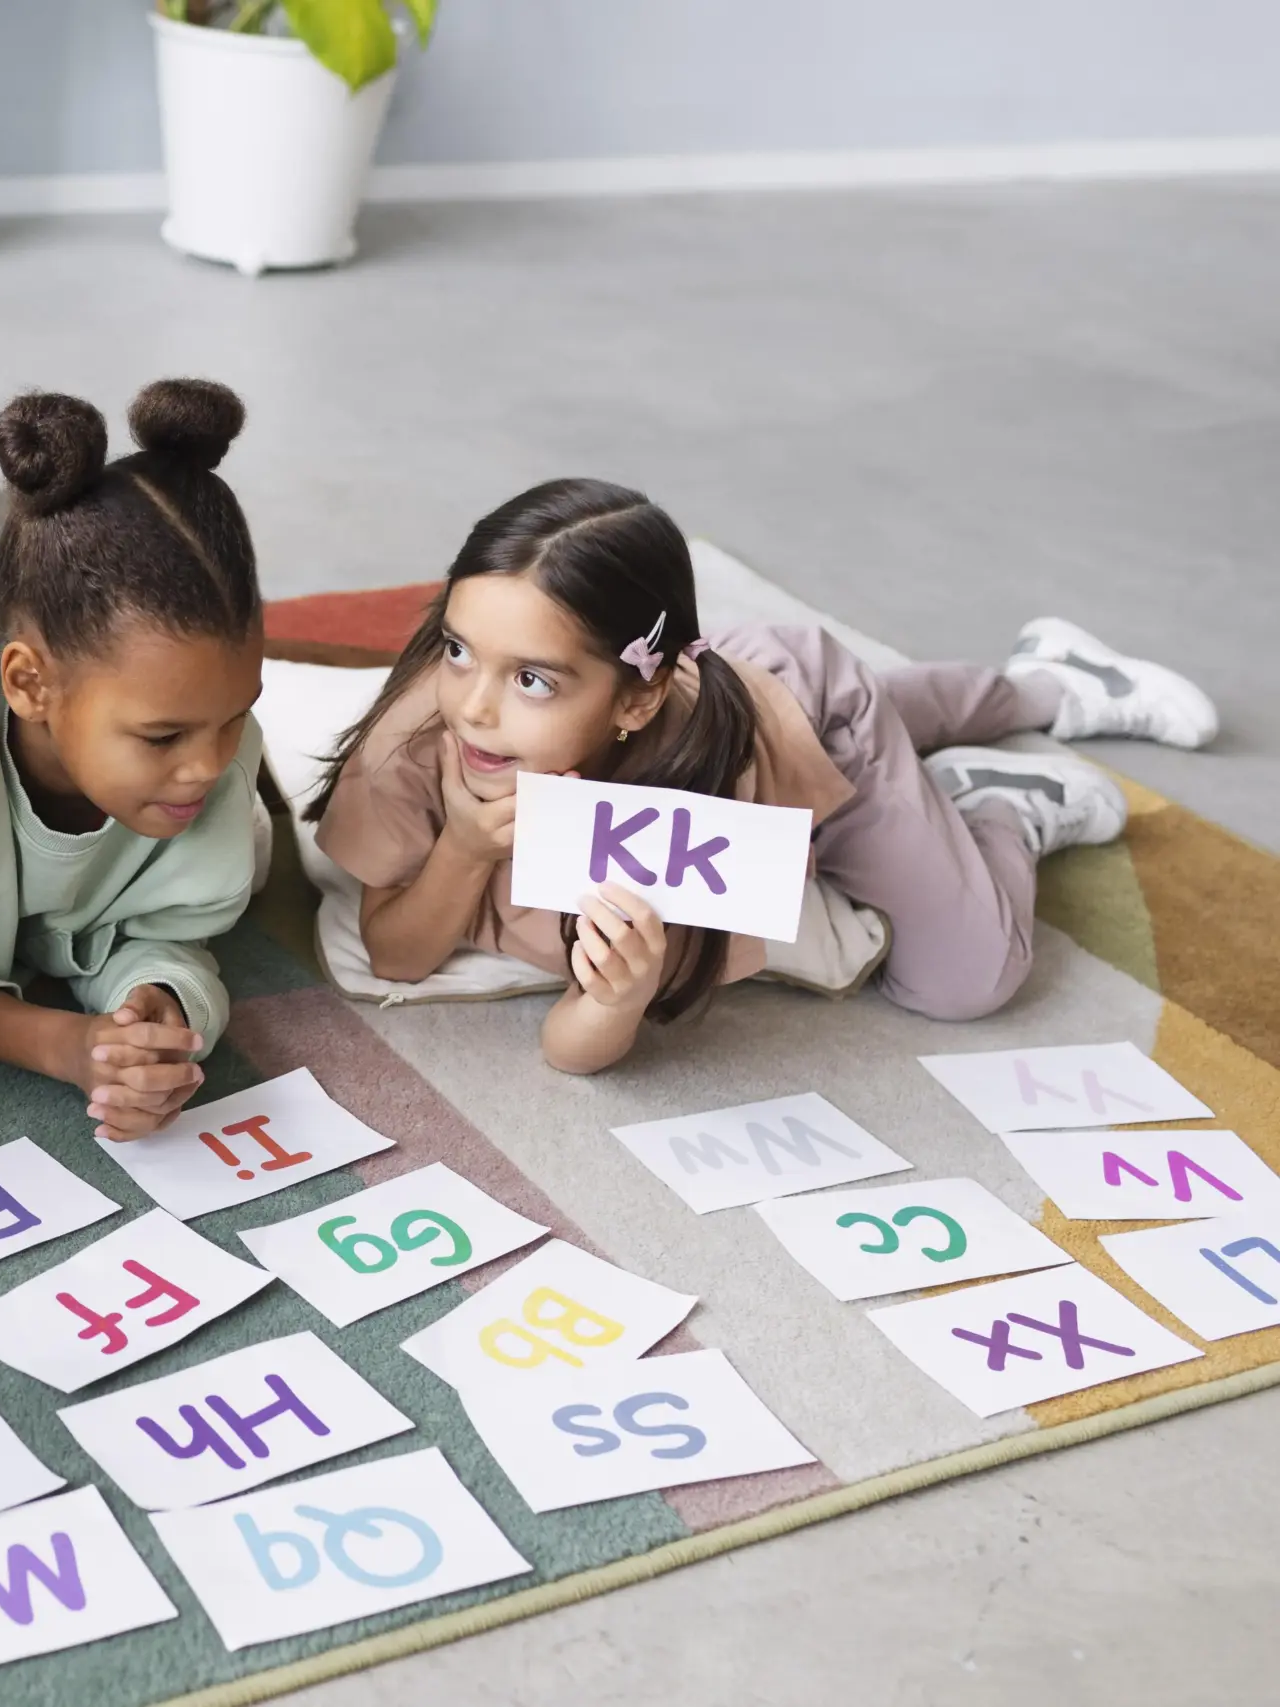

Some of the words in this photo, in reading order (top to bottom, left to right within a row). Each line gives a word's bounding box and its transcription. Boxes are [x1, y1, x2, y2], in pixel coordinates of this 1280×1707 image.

[589, 801, 730, 895] Kk
[1014, 1058, 1155, 1115] Yy
[199, 1115, 312, 1180] Ii
[669, 1115, 862, 1176] Ww
[1103, 1151, 1243, 1202] Vv
[318, 1209, 472, 1274] Gg
[836, 1206, 967, 1263] Cc
[56, 1259, 200, 1354] Ff
[478, 1286, 625, 1368] Bb
[951, 1300, 1136, 1371] Xx
[135, 1374, 330, 1470] Hh
[551, 1392, 707, 1459] Ss
[234, 1504, 443, 1591] Qq
